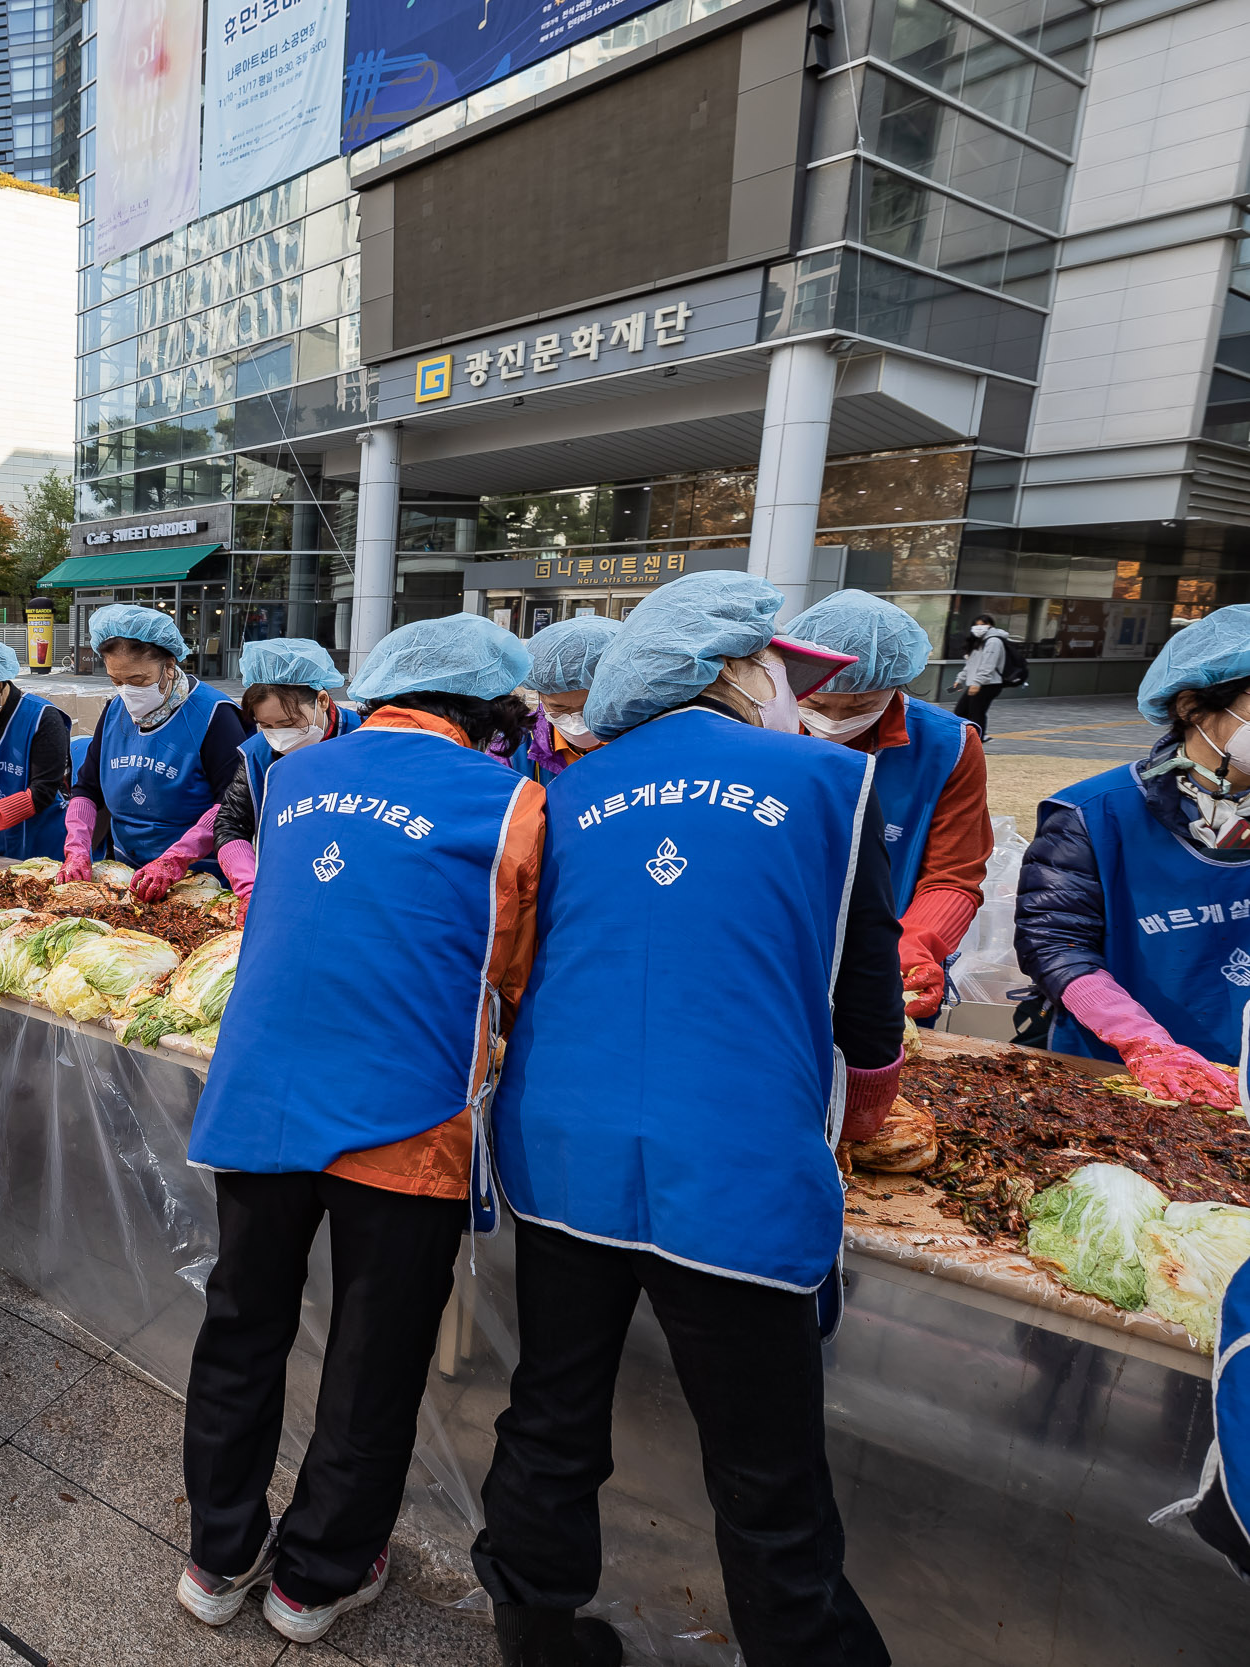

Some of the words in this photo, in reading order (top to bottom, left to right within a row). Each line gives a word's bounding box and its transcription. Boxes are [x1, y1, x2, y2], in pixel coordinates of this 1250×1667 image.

[227, 43, 278, 82] 나루아트센터
[281, 21, 317, 54] 소공연장
[463, 301, 693, 388] 광진문화재단
[86, 531, 111, 546] Cafe
[112, 526, 149, 543] SWEET
[149, 520, 197, 539] GARDEN
[557, 554, 685, 578] 나루아트센터
[577, 577, 599, 585] Naru
[603, 575, 621, 584] Arts
[625, 574, 659, 583] Center
[277, 792, 435, 840] 바르게살기운동
[577, 779, 790, 831] 바르게살기운동
